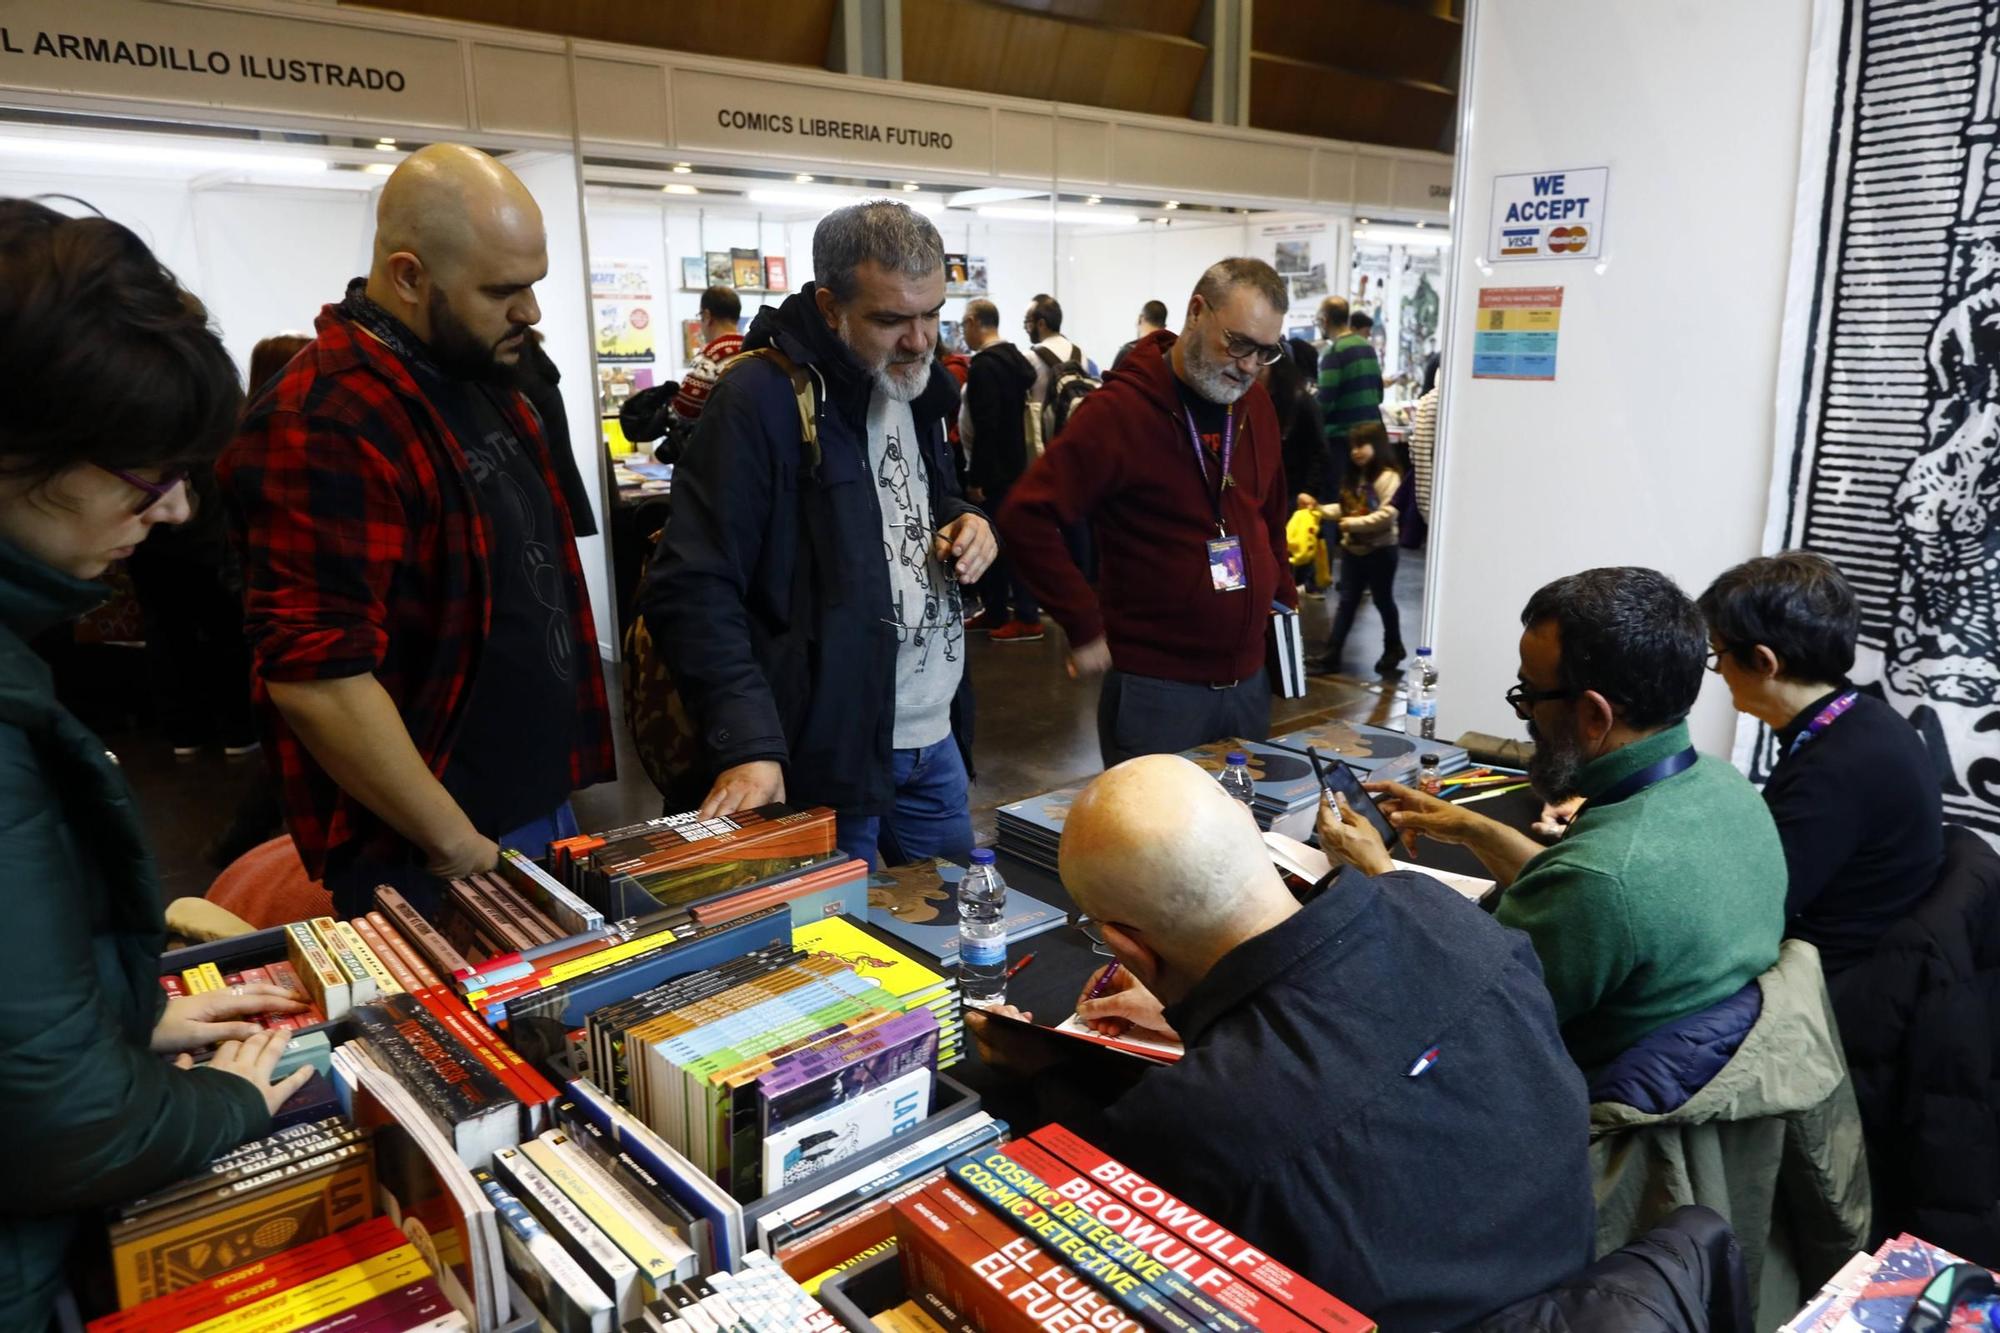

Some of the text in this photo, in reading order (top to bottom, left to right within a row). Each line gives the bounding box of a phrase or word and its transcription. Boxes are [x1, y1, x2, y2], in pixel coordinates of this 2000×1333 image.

[33, 32, 231, 75] ARMADILLO
[240, 54, 405, 92] ILUSTRADO
[717, 109, 953, 149] COMICS LIBRERIA FUTURO
[1533, 174, 1565, 196] WE
[1505, 198, 1590, 222] ACCEPT
[1507, 236, 1534, 247] VISA
[267, 1137, 278, 1145] Y
[280, 1122, 318, 1140] VIDA
[318, 1117, 341, 1128] LA
[211, 1126, 345, 1174] LA VIDA Y USTED
[241, 1154, 290, 1174] USTED
[293, 1149, 305, 1158] Y
[307, 1137, 342, 1153] VIDA
[233, 1145, 357, 1191] LA VIDA Y USTED
[959, 1164, 1143, 1295] COSMIC DETECTIVE
[985, 1155, 1059, 1206] COSMIC
[1051, 1201, 1169, 1283] DETECTIVE
[1056, 1177, 1233, 1288] BEOWULF
[1090, 1161, 1266, 1268] BEOWULF
[971, 1252, 1016, 1290] EL
[1000, 1237, 1148, 1333] EL FUEGO
